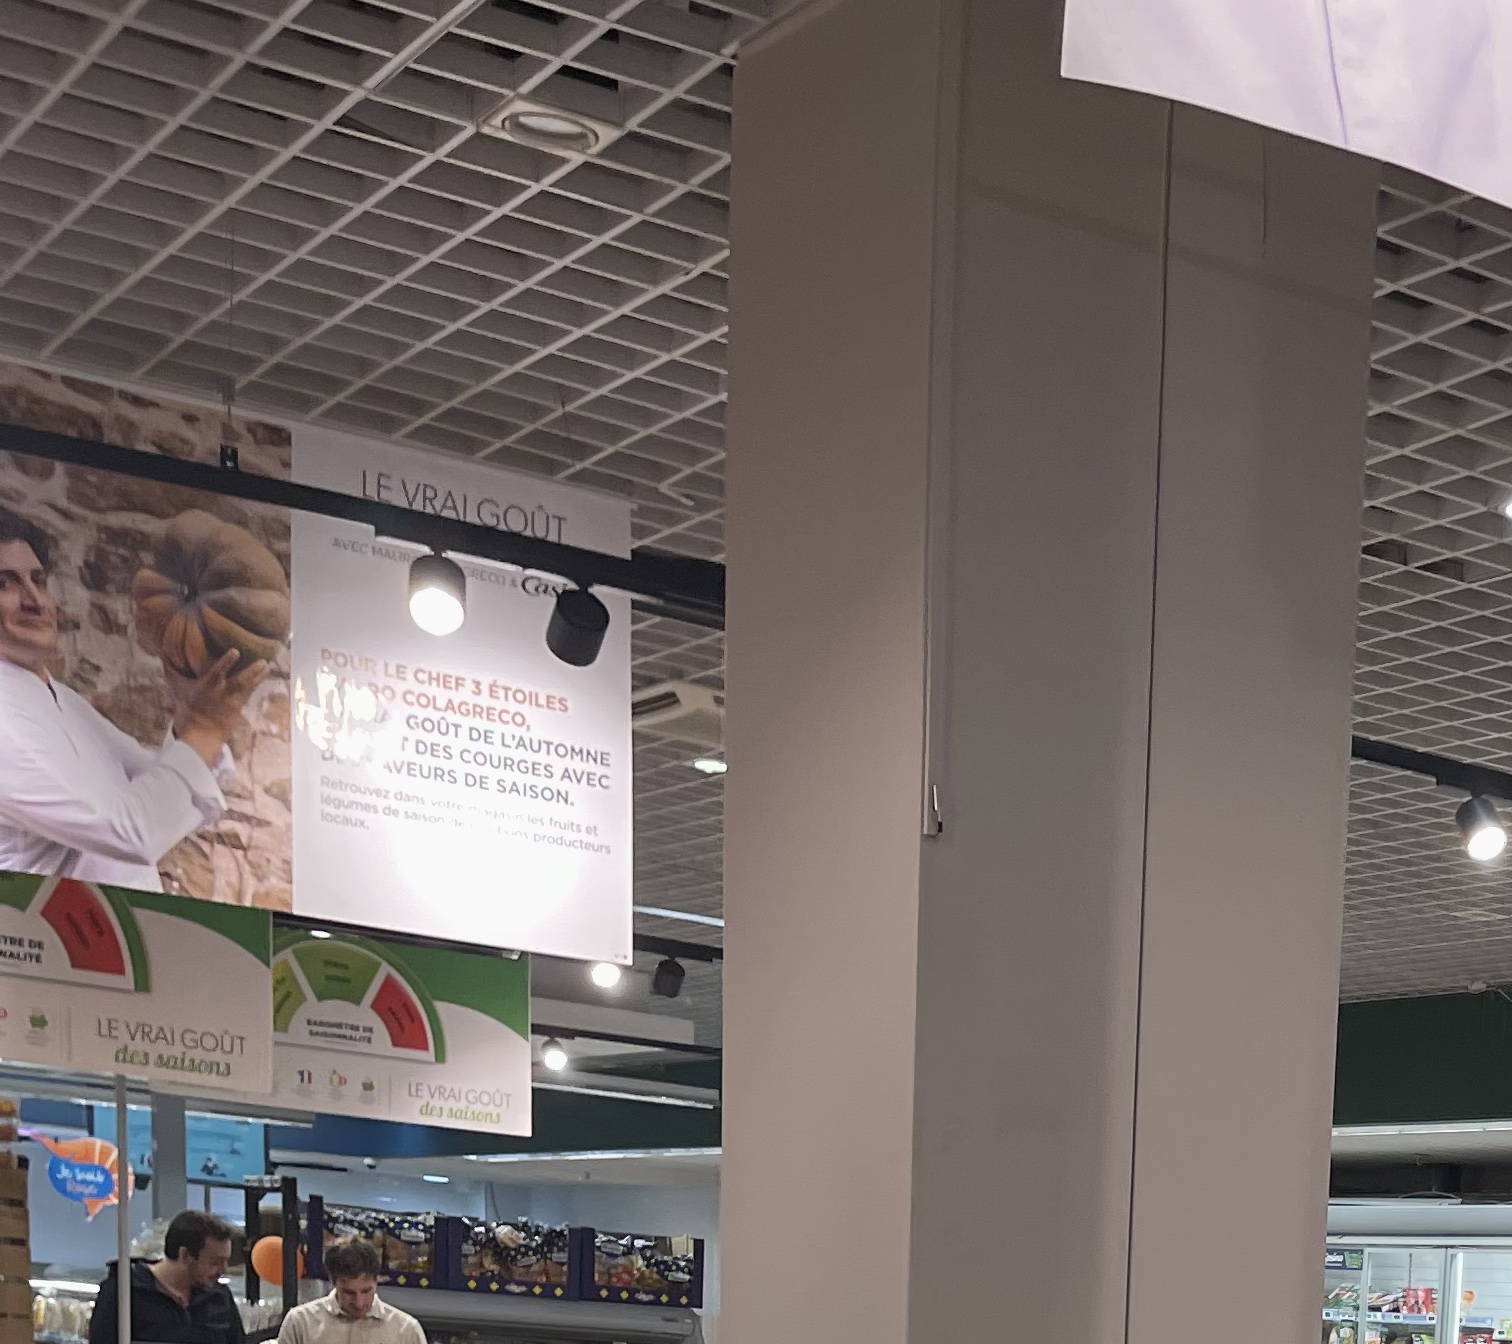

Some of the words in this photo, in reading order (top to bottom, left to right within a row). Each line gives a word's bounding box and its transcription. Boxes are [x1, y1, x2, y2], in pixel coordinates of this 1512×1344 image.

[361, 470, 392, 501] LE
[401, 479, 467, 521] VRAI
[476, 500, 568, 544] GOÛT
[320, 648, 377, 676] POUR
[384, 660, 408, 682] LE
[413, 667, 466, 691] CHEF
[471, 679, 482, 697] 3
[488, 679, 569, 713] ÉTOILES
[402, 689, 532, 732] COLAGRECO,
[405, 714, 463, 740] GOÛT
[468, 726, 495, 746] DE
[414, 739, 453, 761] DES
[459, 748, 554, 780] COURGES
[560, 770, 612, 791] AVEC
[320, 775, 391, 801] Retrouvez
[394, 789, 426, 807] dans
[527, 813, 545, 827] les
[548, 815, 583, 835] fruits
[585, 823, 599, 837] et
[464, 772, 490, 791] DE
[496, 779, 576, 808] SAISON.
[320, 793, 379, 815] légumes
[382, 802, 400, 818] de
[533, 832, 612, 855] producteurs
[97, 1016, 118, 1039] LE
[124, 1020, 176, 1047] VRAI
[181, 1028, 247, 1056] GOÛT
[114, 1044, 149, 1067] des
[153, 1051, 231, 1077] saisons
[407, 1081, 426, 1099] LE
[427, 1082, 462, 1102] VRAI
[465, 1088, 512, 1109] GOÛT
[419, 1100, 442, 1118] des
[446, 1105, 501, 1125] saisons
